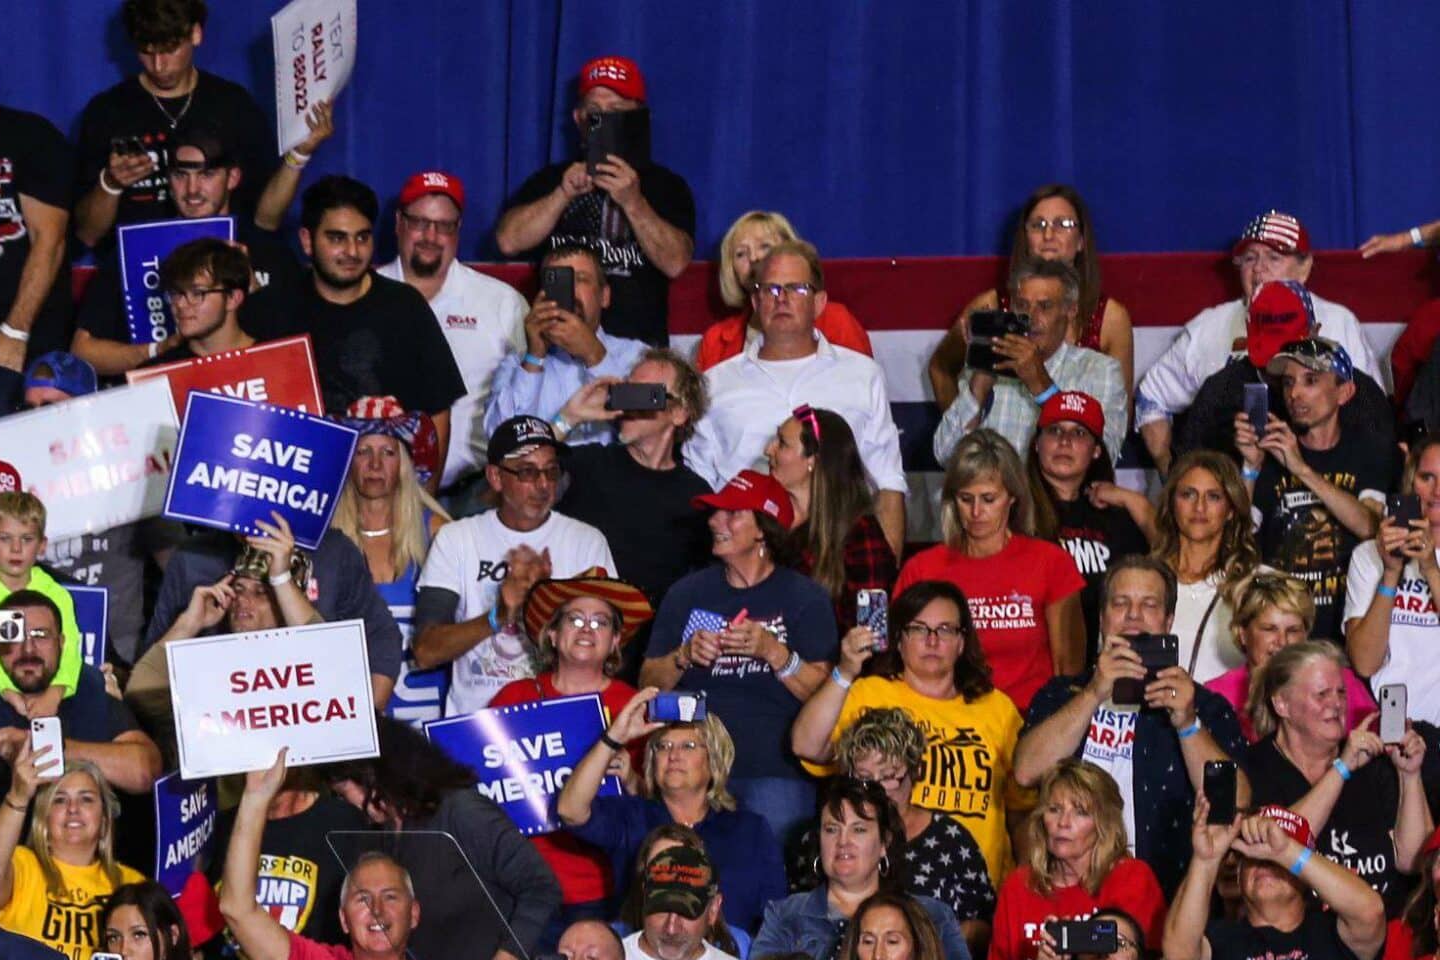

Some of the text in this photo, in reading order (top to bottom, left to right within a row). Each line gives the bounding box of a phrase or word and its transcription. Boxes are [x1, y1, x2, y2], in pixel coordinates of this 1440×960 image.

[311, 22, 327, 83] RALLY
[331, 12, 344, 60] TEXT
[292, 22, 308, 115] TO 88022
[142, 256, 168, 342] TO 880
[210, 377, 268, 402] AVE
[48, 424, 131, 465] SAVE
[232, 434, 314, 474] SAVE
[0, 472, 15, 484] GO
[187, 462, 329, 516] AMERICA!
[476, 560, 508, 581] BO
[990, 619, 1036, 629] GENERAL
[229, 664, 315, 695] SAVE
[198, 697, 356, 737] AMERICA!
[482, 731, 566, 769] SAVE
[918, 743, 993, 791] GIRLS
[180, 784, 208, 824] SAVE
[477, 768, 574, 804] MERIC
[921, 785, 991, 811] PORTS
[282, 859, 313, 881] FOR
[256, 879, 307, 906] UMP
[42, 903, 105, 949] GIRL
